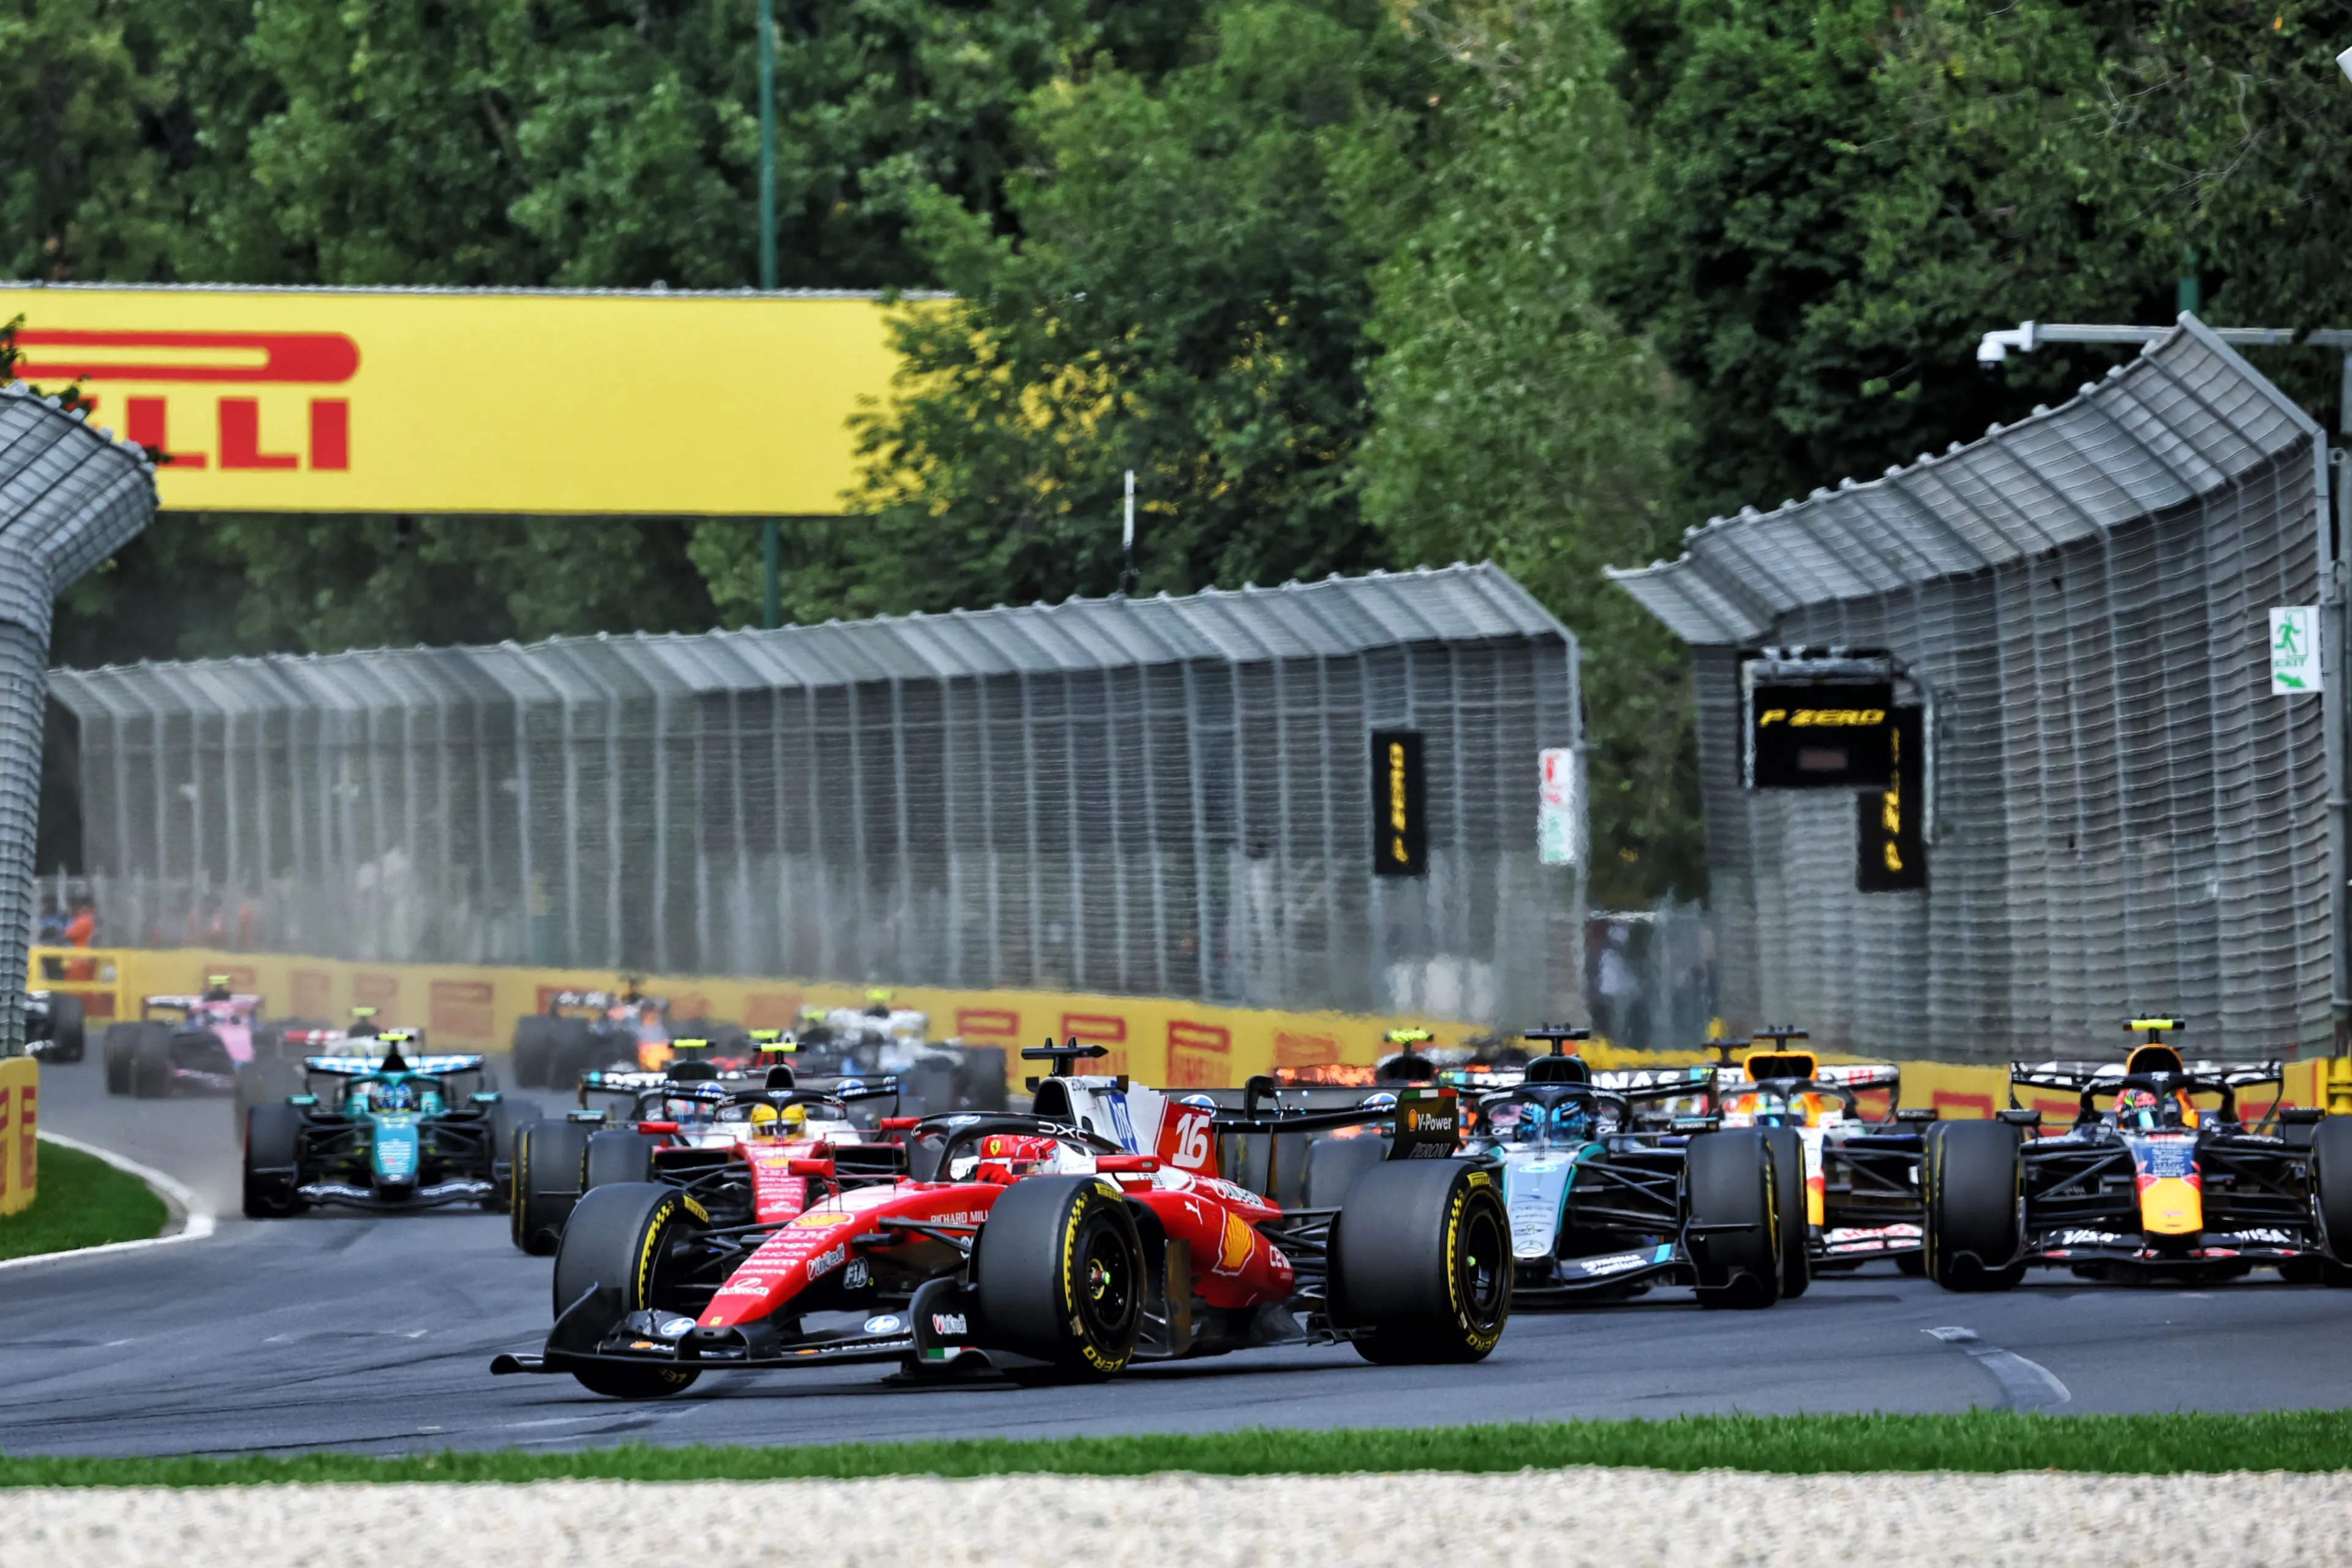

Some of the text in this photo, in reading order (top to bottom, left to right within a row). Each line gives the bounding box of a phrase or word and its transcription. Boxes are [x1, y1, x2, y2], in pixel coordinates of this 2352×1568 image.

[2275, 658, 2306, 666] EXIT
[1789, 709, 1886, 727] ZERO
[1038, 1121, 1088, 1142] DXC
[1417, 1114, 1452, 1131] V-Power
[1172, 1114, 1210, 1169] 16
[1409, 1142, 1451, 1159] PERONI
[1083, 1344, 1124, 1373] ZERO
